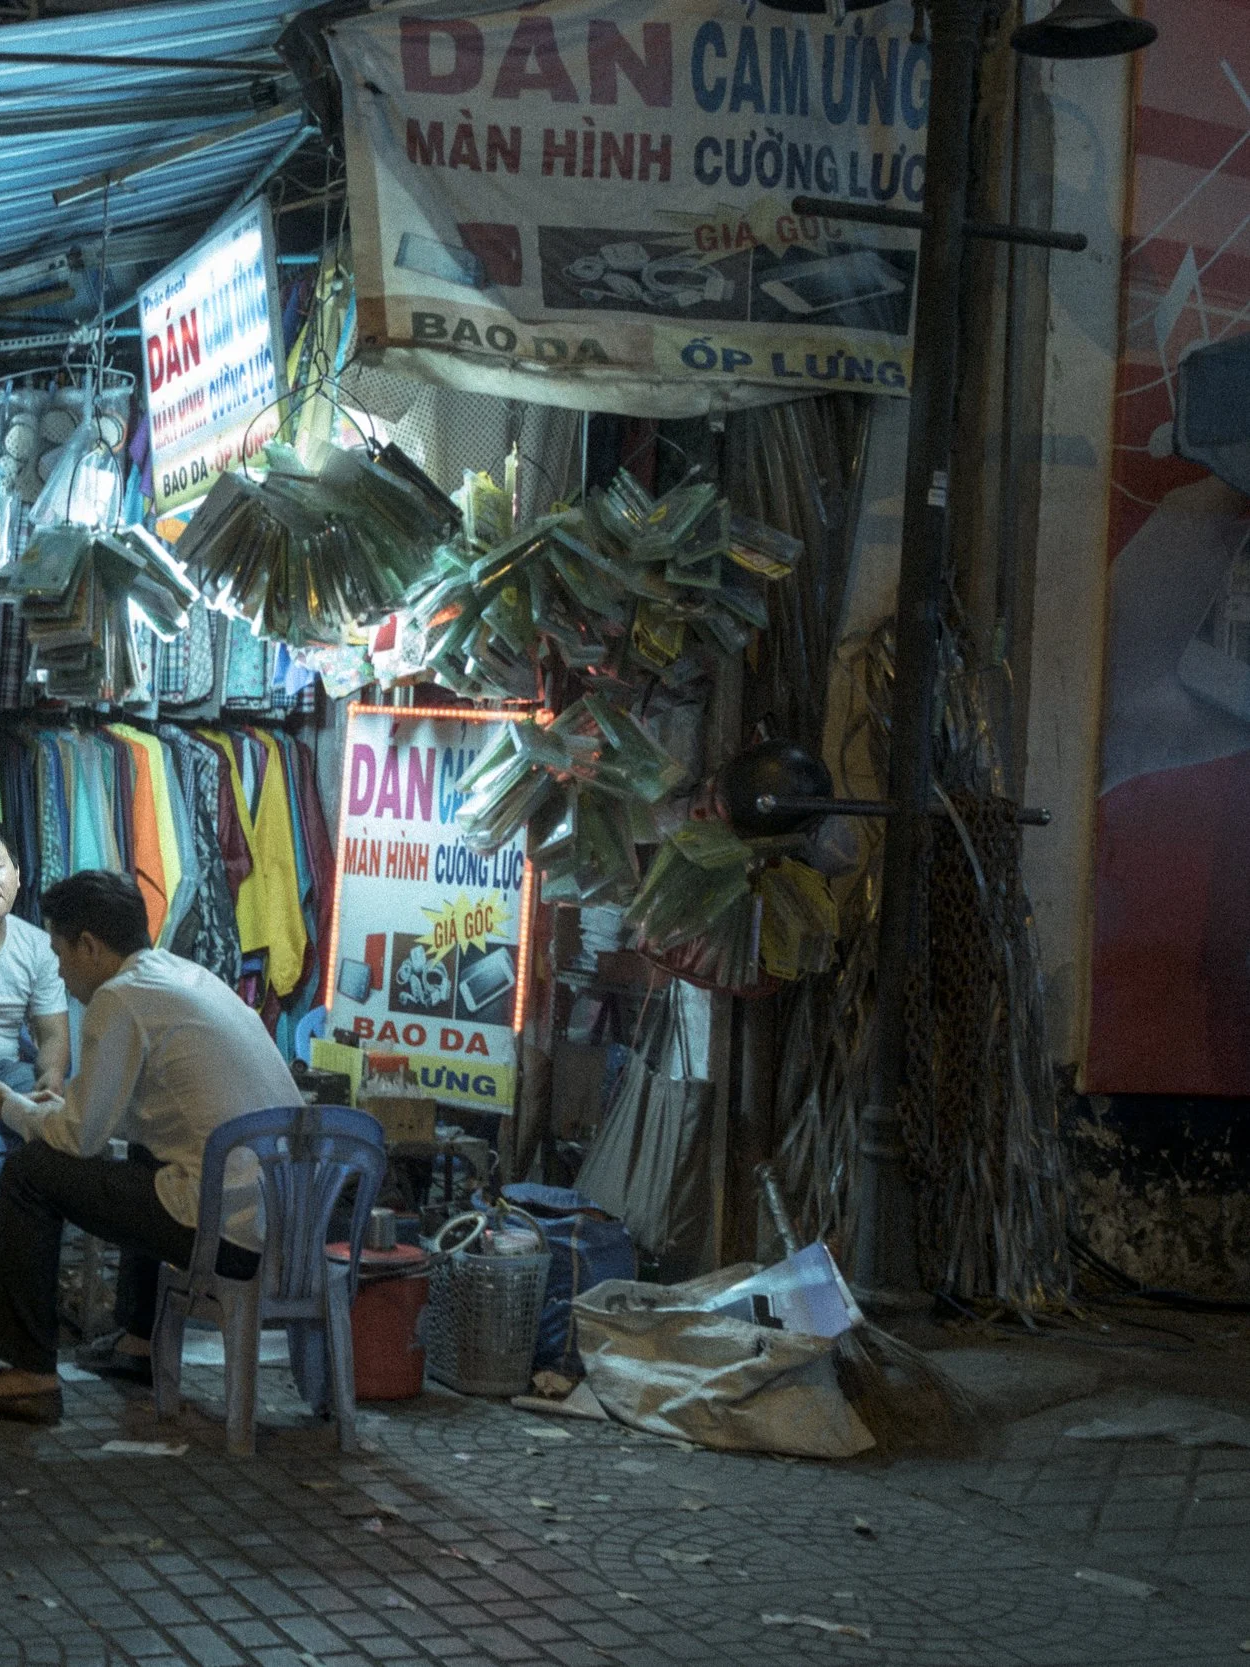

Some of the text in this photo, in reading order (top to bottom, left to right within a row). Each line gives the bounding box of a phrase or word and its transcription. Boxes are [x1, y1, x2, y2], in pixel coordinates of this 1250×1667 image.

[406, 110, 523, 174] MÀN
[542, 117, 674, 182] HÌNH
[694, 126, 838, 194] CƯỜNG
[146, 307, 200, 393] DÁN
[410, 310, 907, 389] BAO DA ỐP LƯNG
[162, 465, 188, 498] BAO
[191, 455, 209, 486] DA
[349, 724, 436, 823] DÁN
[343, 827, 381, 878] MÀN
[385, 830, 429, 882] HÌNH
[493, 842, 525, 900] LỰC
[433, 897, 494, 949] GIÁ GỐC
[352, 1016, 490, 1057] BAO DA
[420, 1064, 497, 1097] ƯNG
